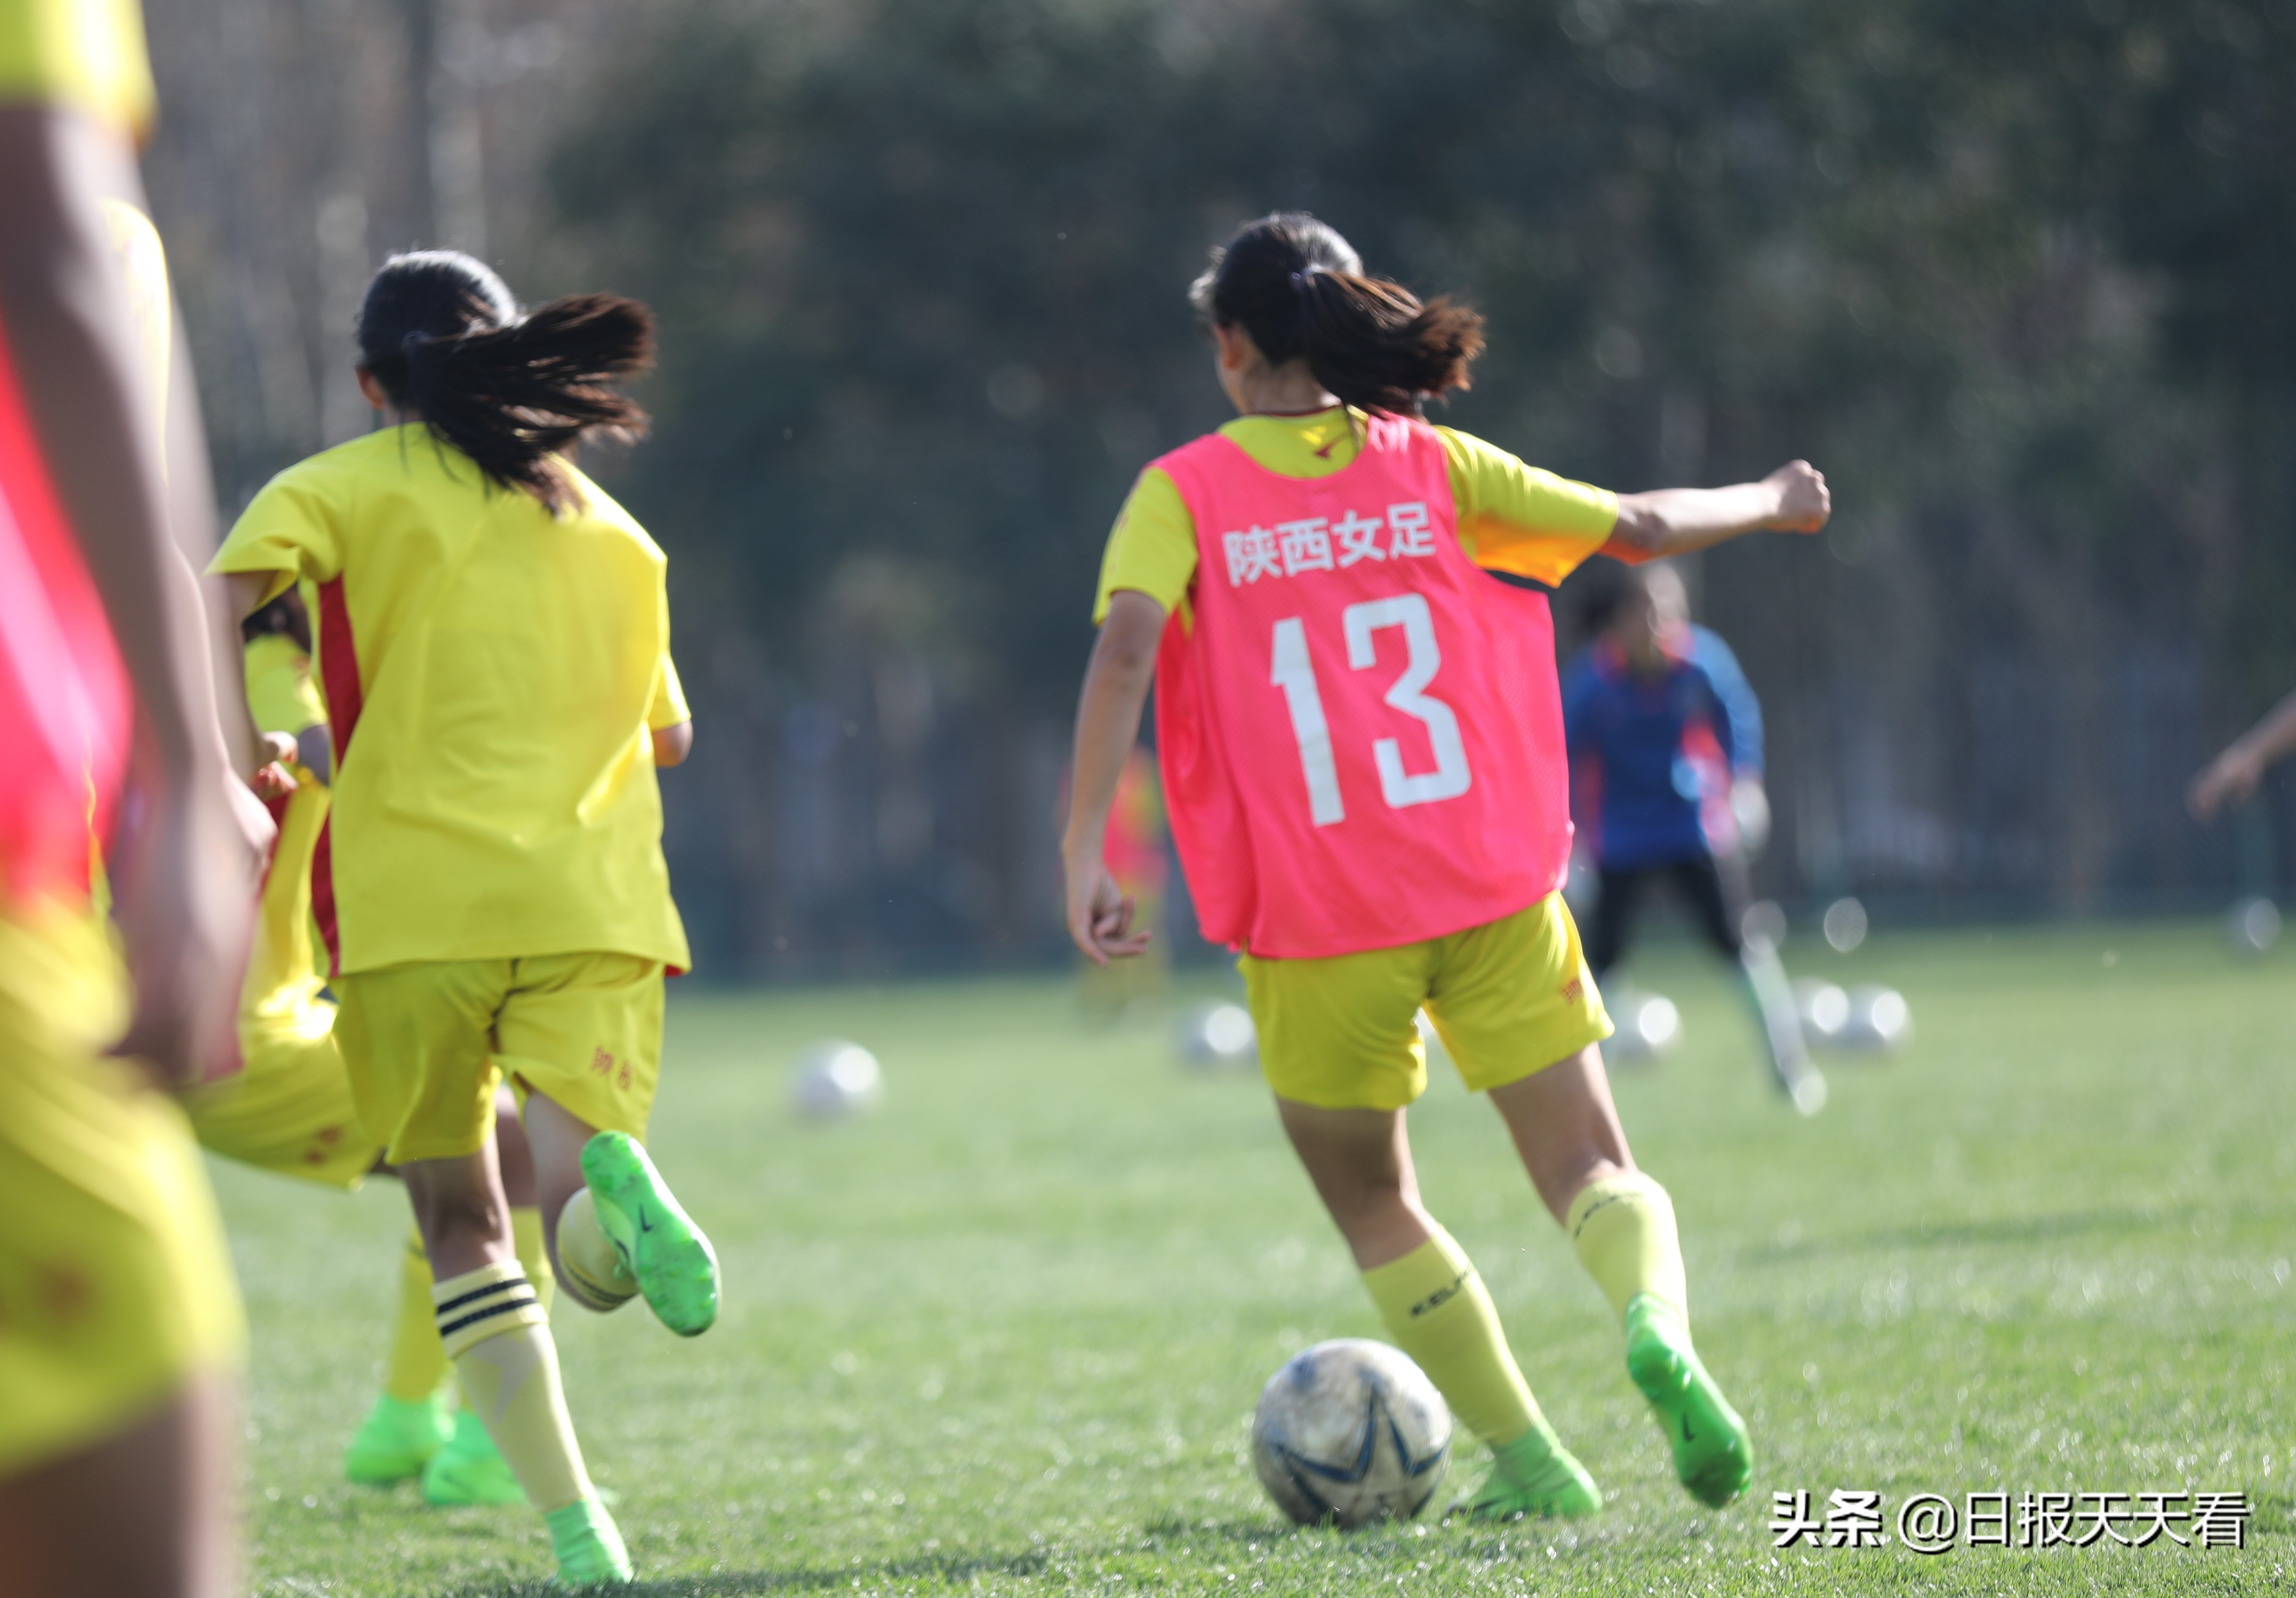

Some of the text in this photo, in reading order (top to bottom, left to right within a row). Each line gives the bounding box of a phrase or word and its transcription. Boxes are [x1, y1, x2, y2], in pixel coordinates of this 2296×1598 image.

[1221, 501, 1436, 588] 陕西女足
[1270, 592, 1472, 828] 13
